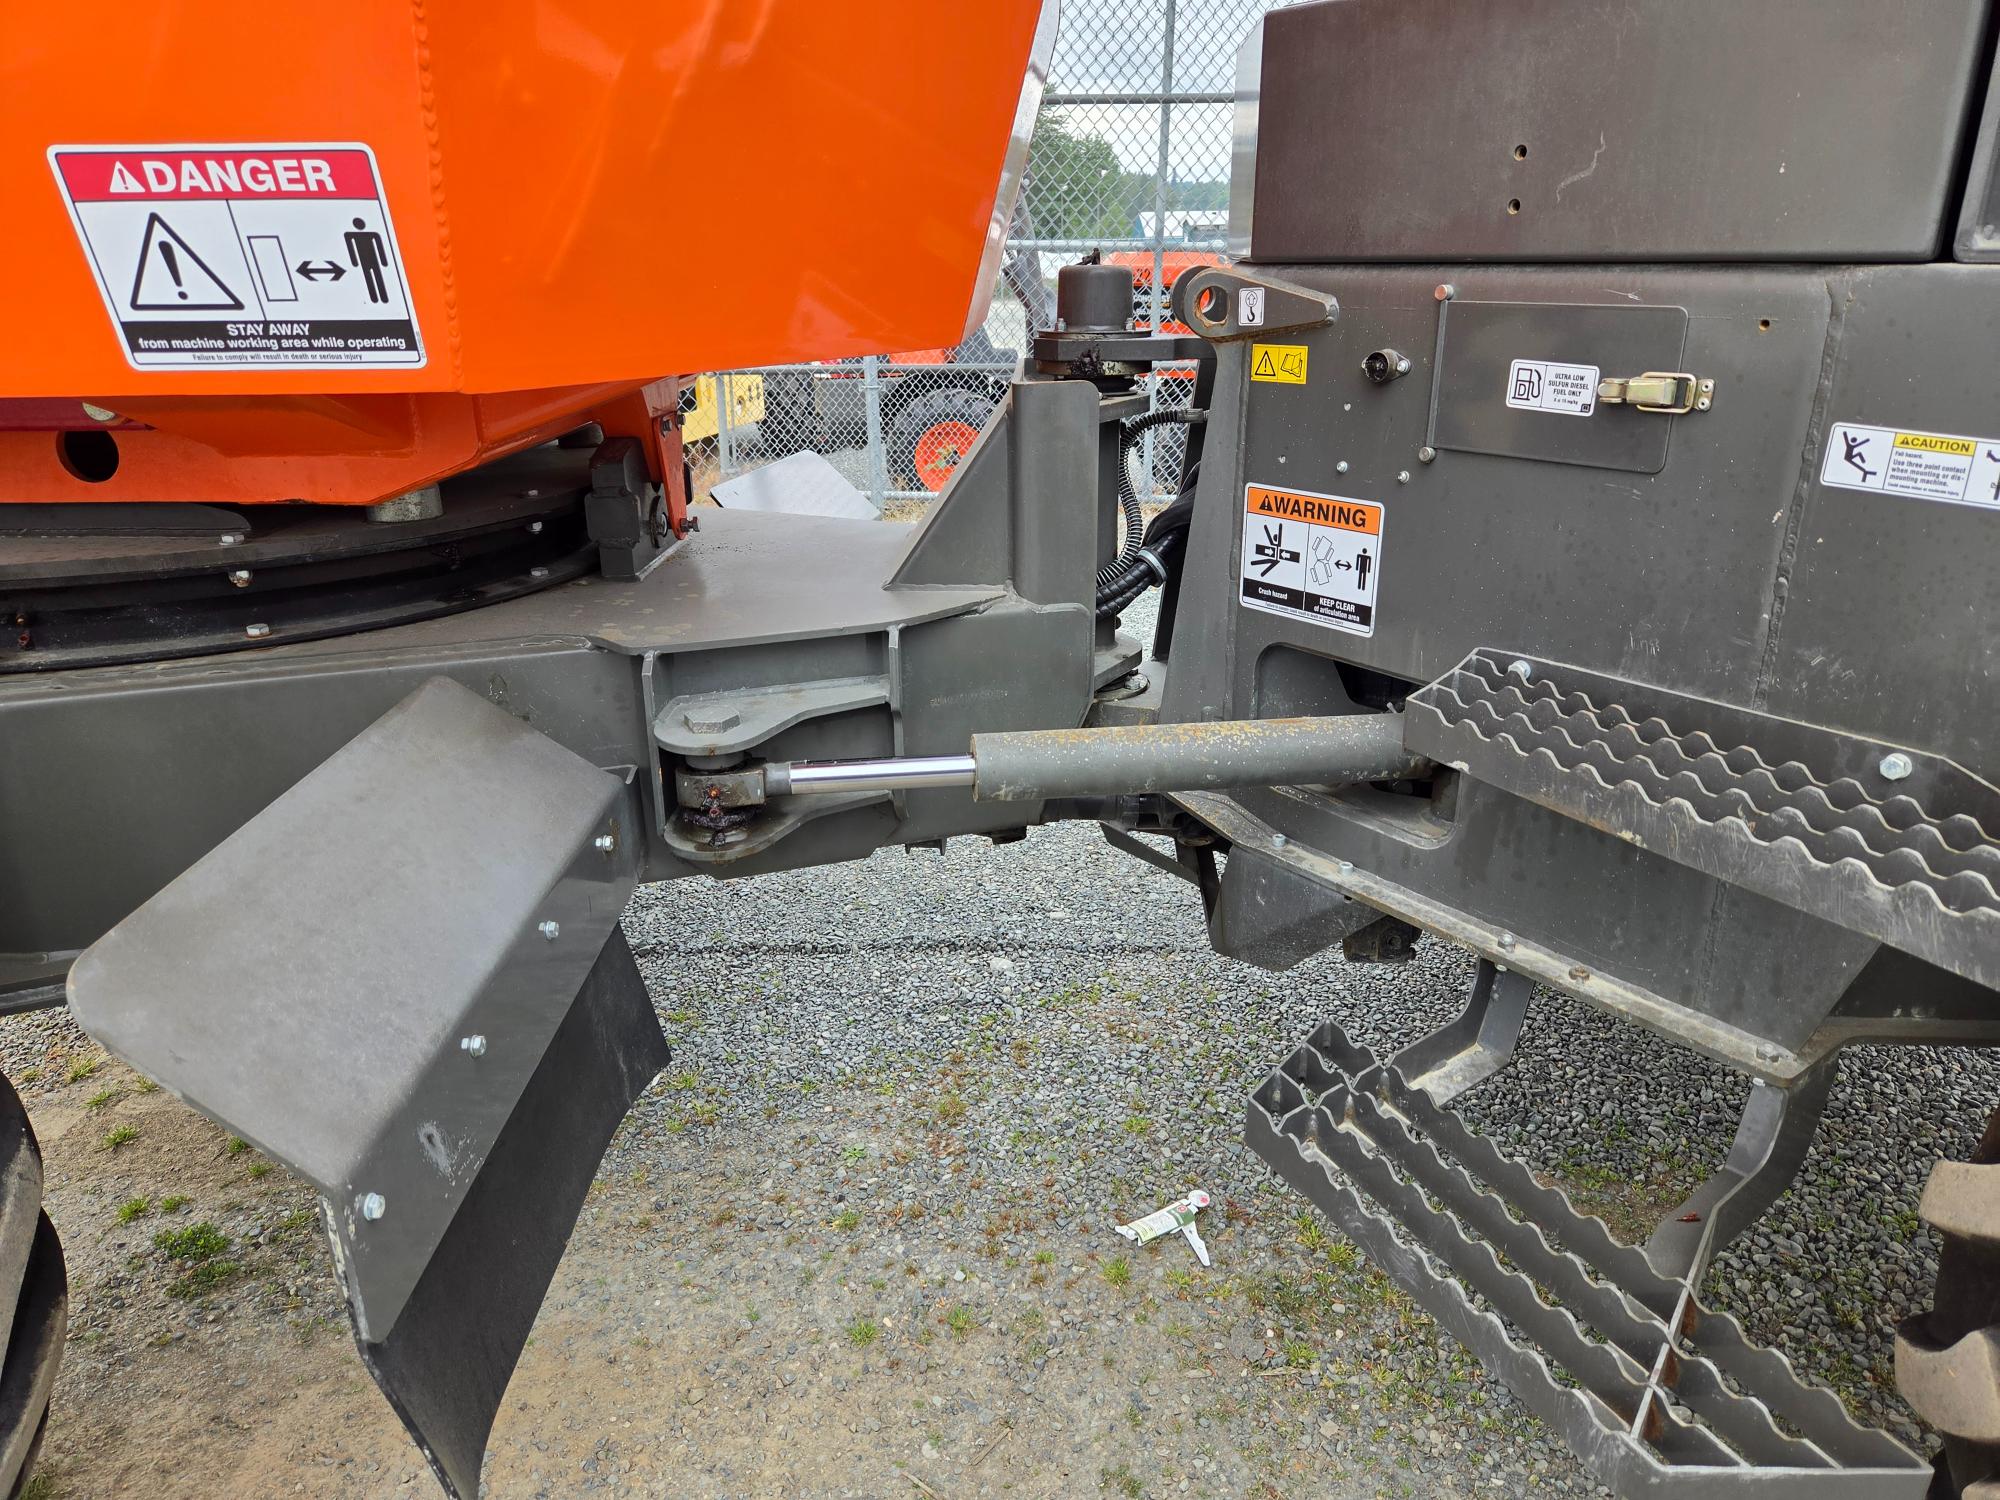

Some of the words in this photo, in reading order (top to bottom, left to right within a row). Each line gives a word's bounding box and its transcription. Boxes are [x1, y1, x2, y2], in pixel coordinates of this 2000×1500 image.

[141, 159, 337, 193] DANGER
[226, 323, 264, 336] STAY
[268, 323, 310, 336] AWAY
[138, 337, 170, 349] from
[171, 337, 225, 349] machine
[227, 337, 279, 350] working
[281, 338, 309, 348] area
[311, 336, 345, 348] while
[347, 336, 406, 350] operating
[192, 353, 215, 361] Failure
[224, 353, 249, 362] comply
[290, 352, 309, 360] death
[319, 352, 343, 360] serious
[343, 352, 363, 361] injury
[1554, 372, 1572, 381] ULTRA
[1572, 374, 1586, 382] LOW
[1548, 380, 1570, 388] SULFUR
[1570, 382, 1590, 391] DIESEL
[1553, 388, 1567, 396] FUEL
[1567, 389, 1582, 398] ONLY
[1910, 436, 1971, 453] CAUTION
[1891, 467, 1909, 475] when
[1909, 469, 1940, 480] mounting
[1941, 472, 1950, 480] or
[1906, 459, 1923, 469] three
[1924, 462, 1941, 472] point
[1942, 465, 1967, 474] contact
[1889, 474, 1919, 484] mounting
[1919, 477, 1949, 487] machine.
[1273, 495, 1367, 528] WARNING
[1258, 586, 1272, 597] Crush
[1272, 589, 1288, 600] hazard
[1319, 597, 1335, 608] KEEP
[1335, 600, 1356, 613] CLEAR
[1313, 604, 1320, 613] of
[1320, 605, 1348, 619] articulation
[1348, 613, 1360, 622] area
